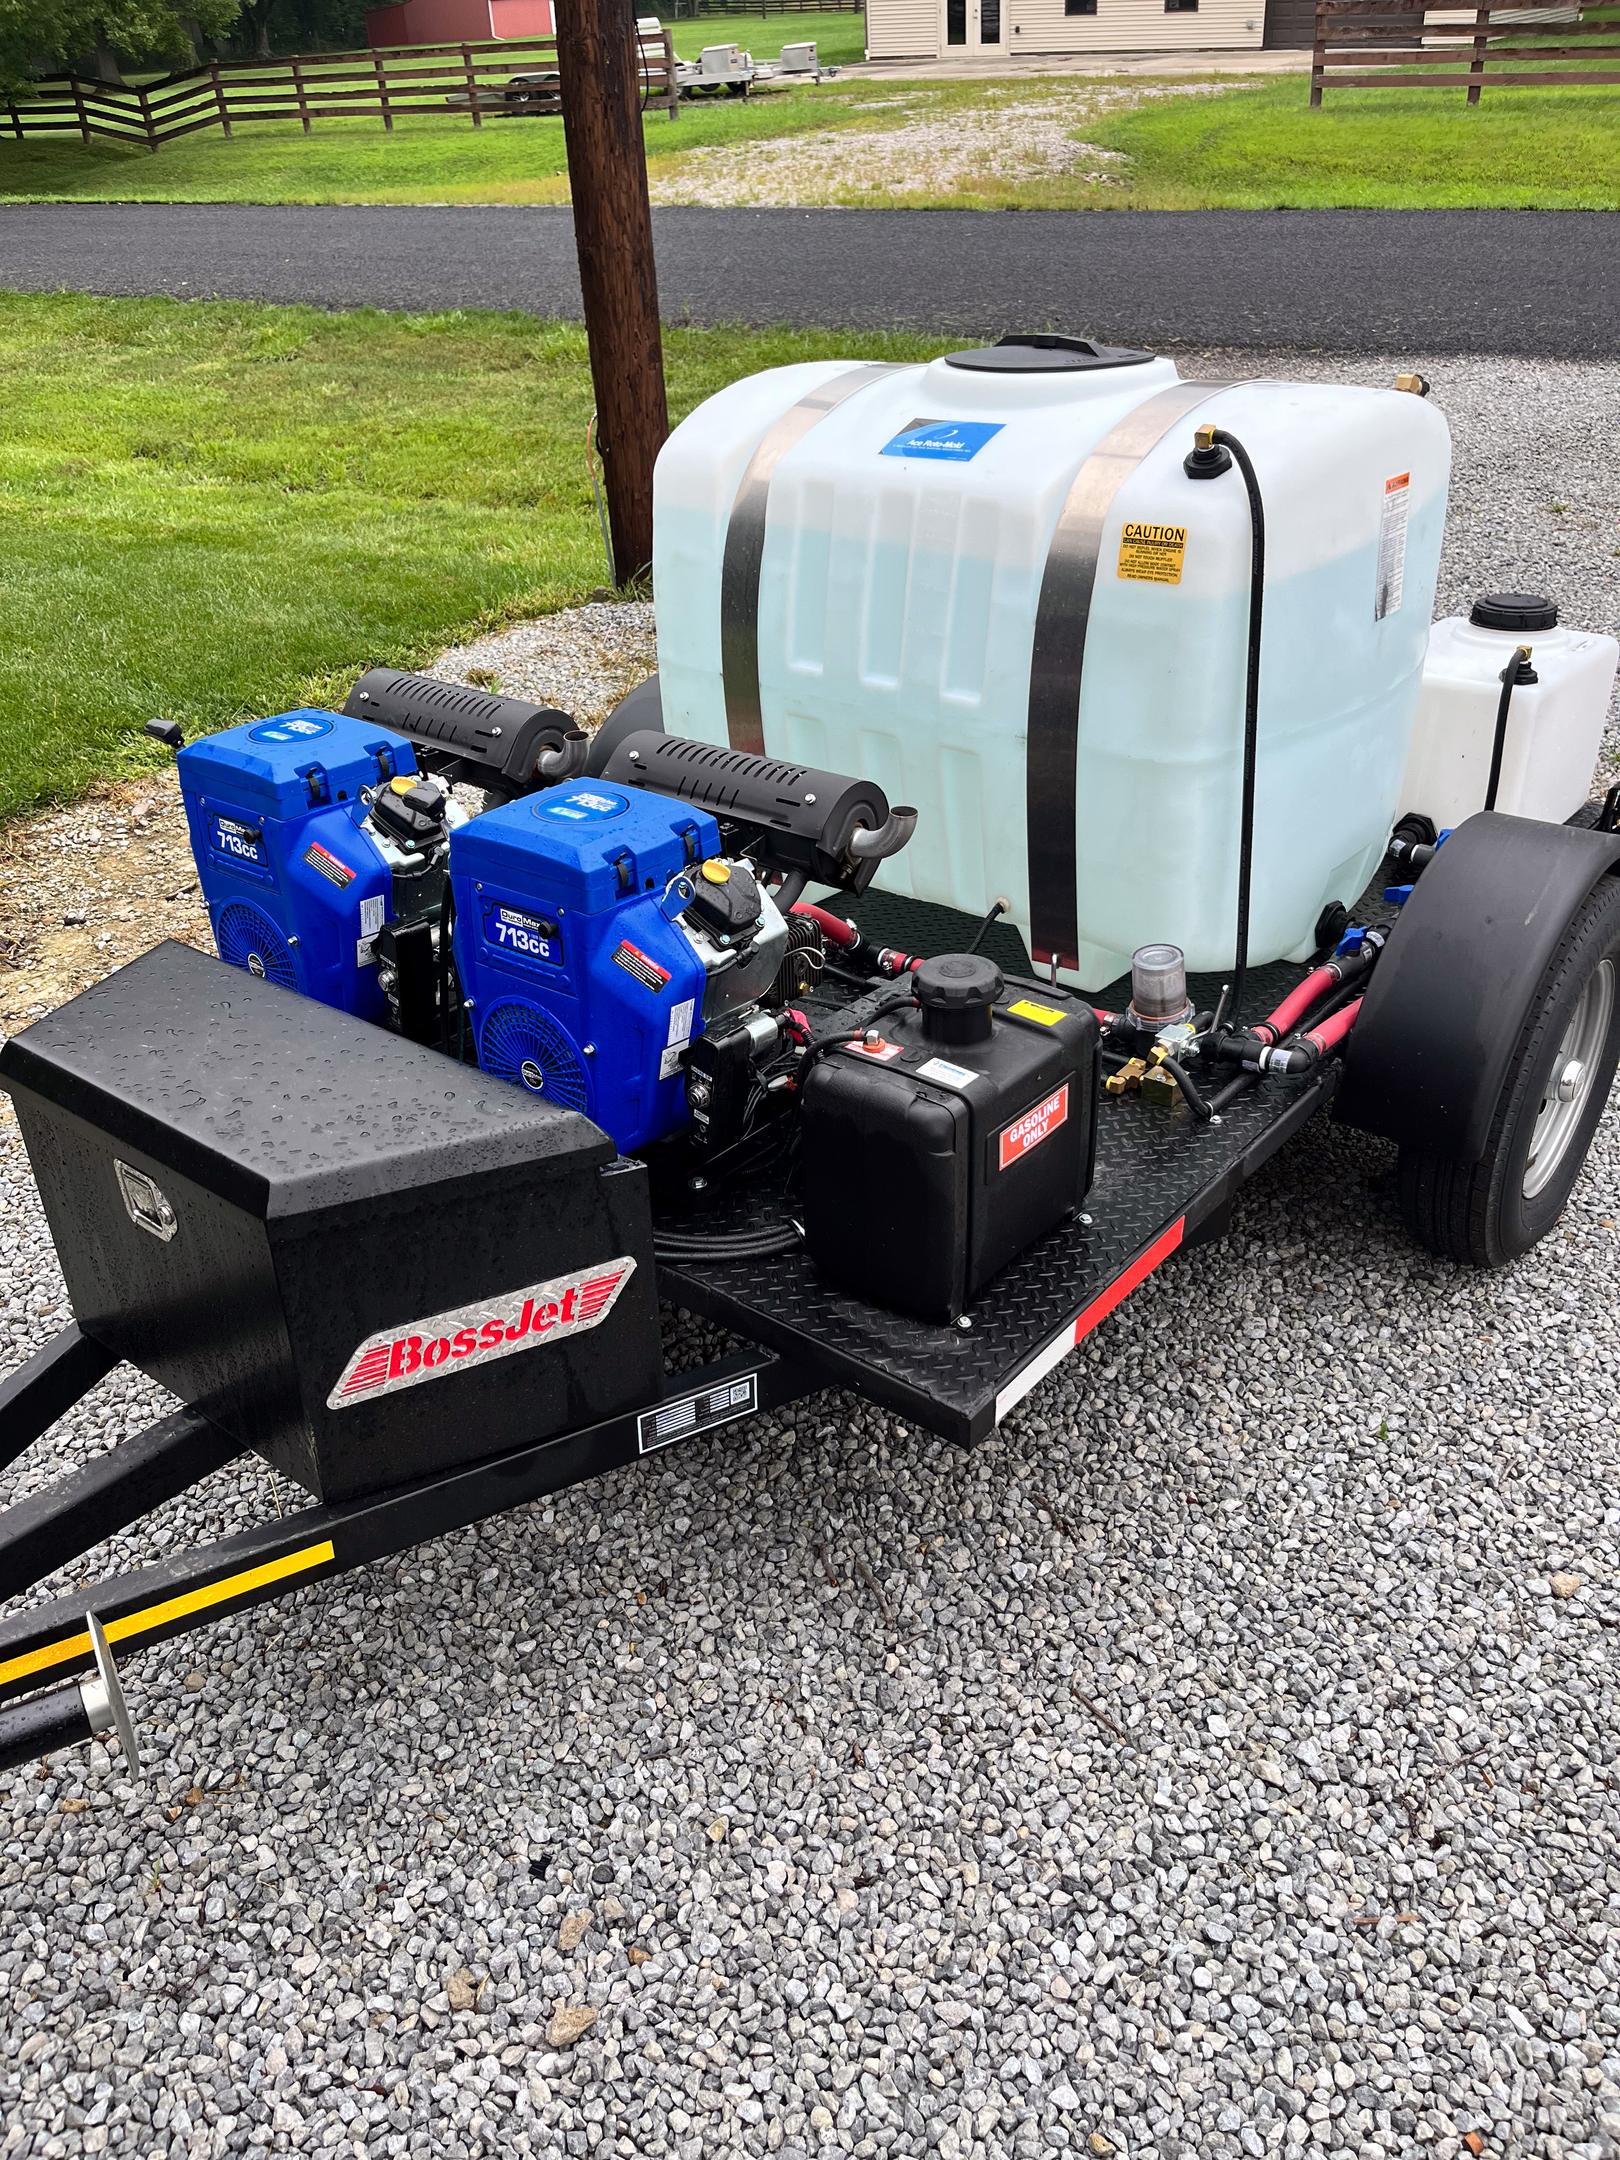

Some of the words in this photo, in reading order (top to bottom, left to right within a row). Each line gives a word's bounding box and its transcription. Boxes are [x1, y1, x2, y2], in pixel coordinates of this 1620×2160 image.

[1125, 524, 1185, 541] CAUTION
[217, 831, 258, 860] 713cc
[496, 922, 550, 957] 713cc
[1010, 1096, 1060, 1143] GASOLINE
[1023, 1119, 1048, 1147] ONLY
[388, 1287, 578, 1380] BossJet
